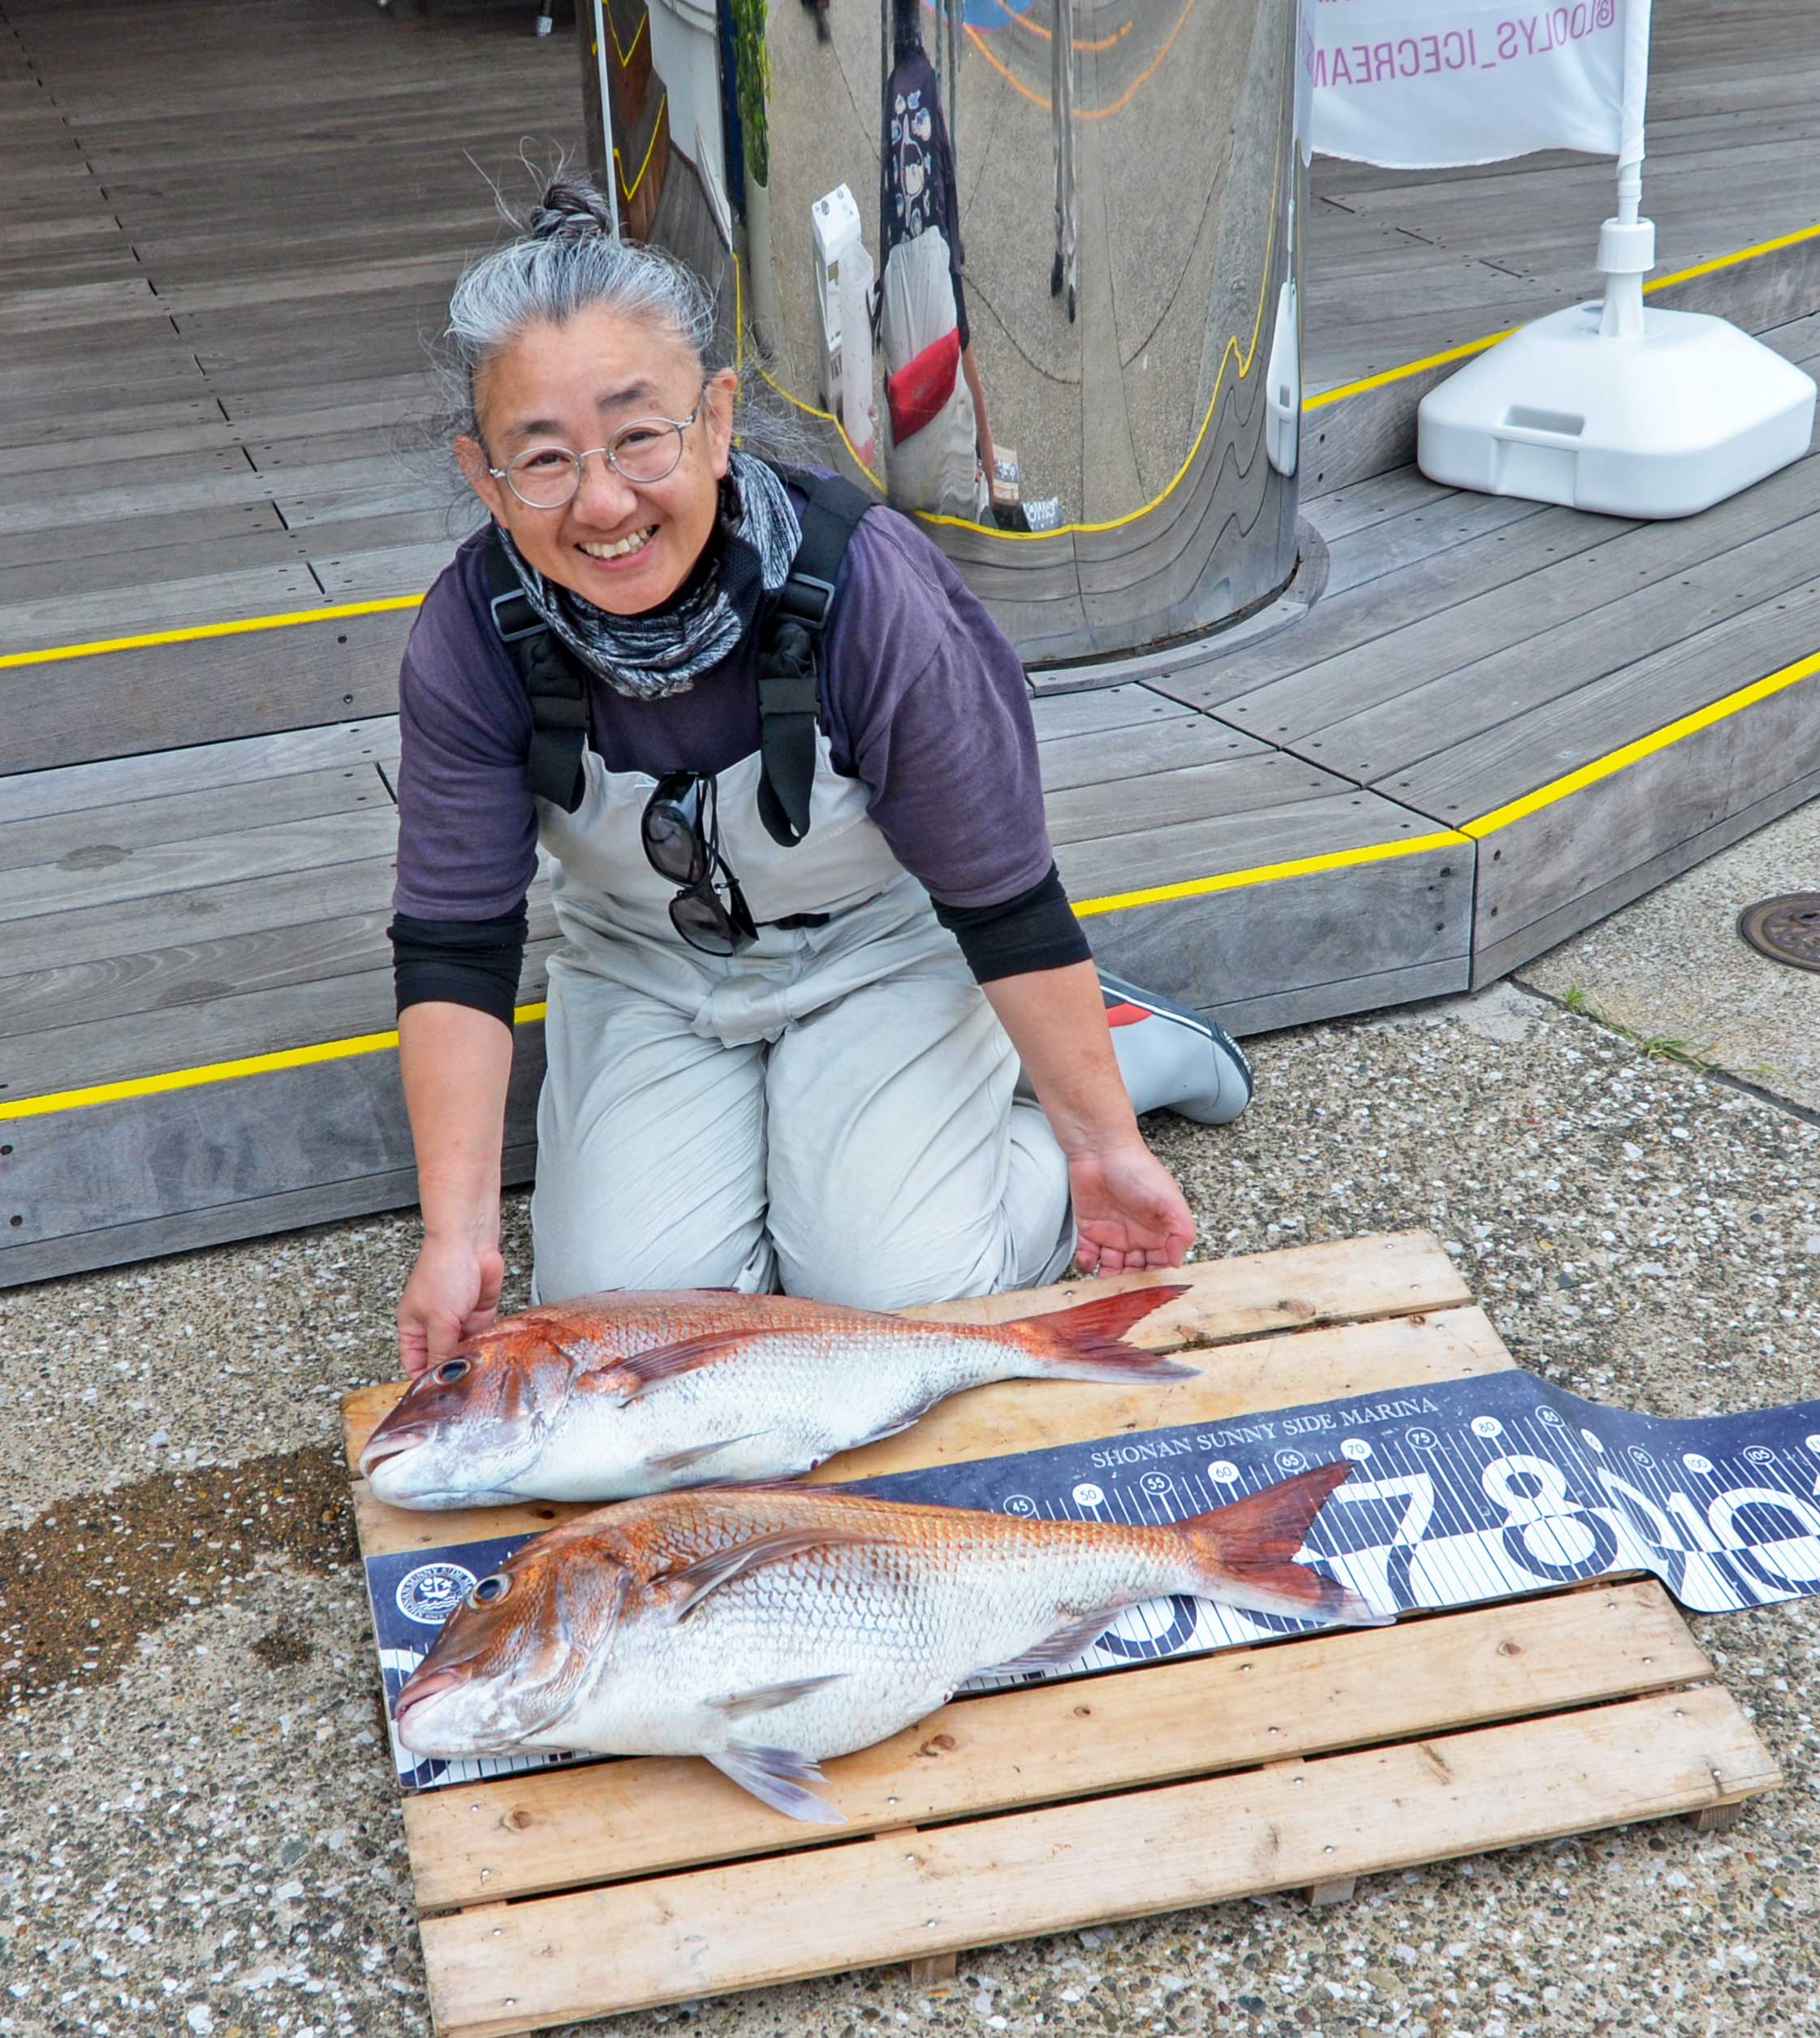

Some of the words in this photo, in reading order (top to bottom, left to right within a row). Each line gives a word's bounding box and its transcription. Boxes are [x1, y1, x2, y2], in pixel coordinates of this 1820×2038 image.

[1090, 1438, 1192, 1468] SHONAN
[1197, 1423, 1276, 1450] SUNNY
[1282, 1414, 1337, 1436] SIDE
[1340, 1397, 1438, 1427] MARINA
[1331, 1472, 1435, 1609] 7
[1481, 1454, 1619, 1582] 8
[404, 1566, 438, 1588] SUNNY
[401, 1588, 423, 1618] SHONAN
